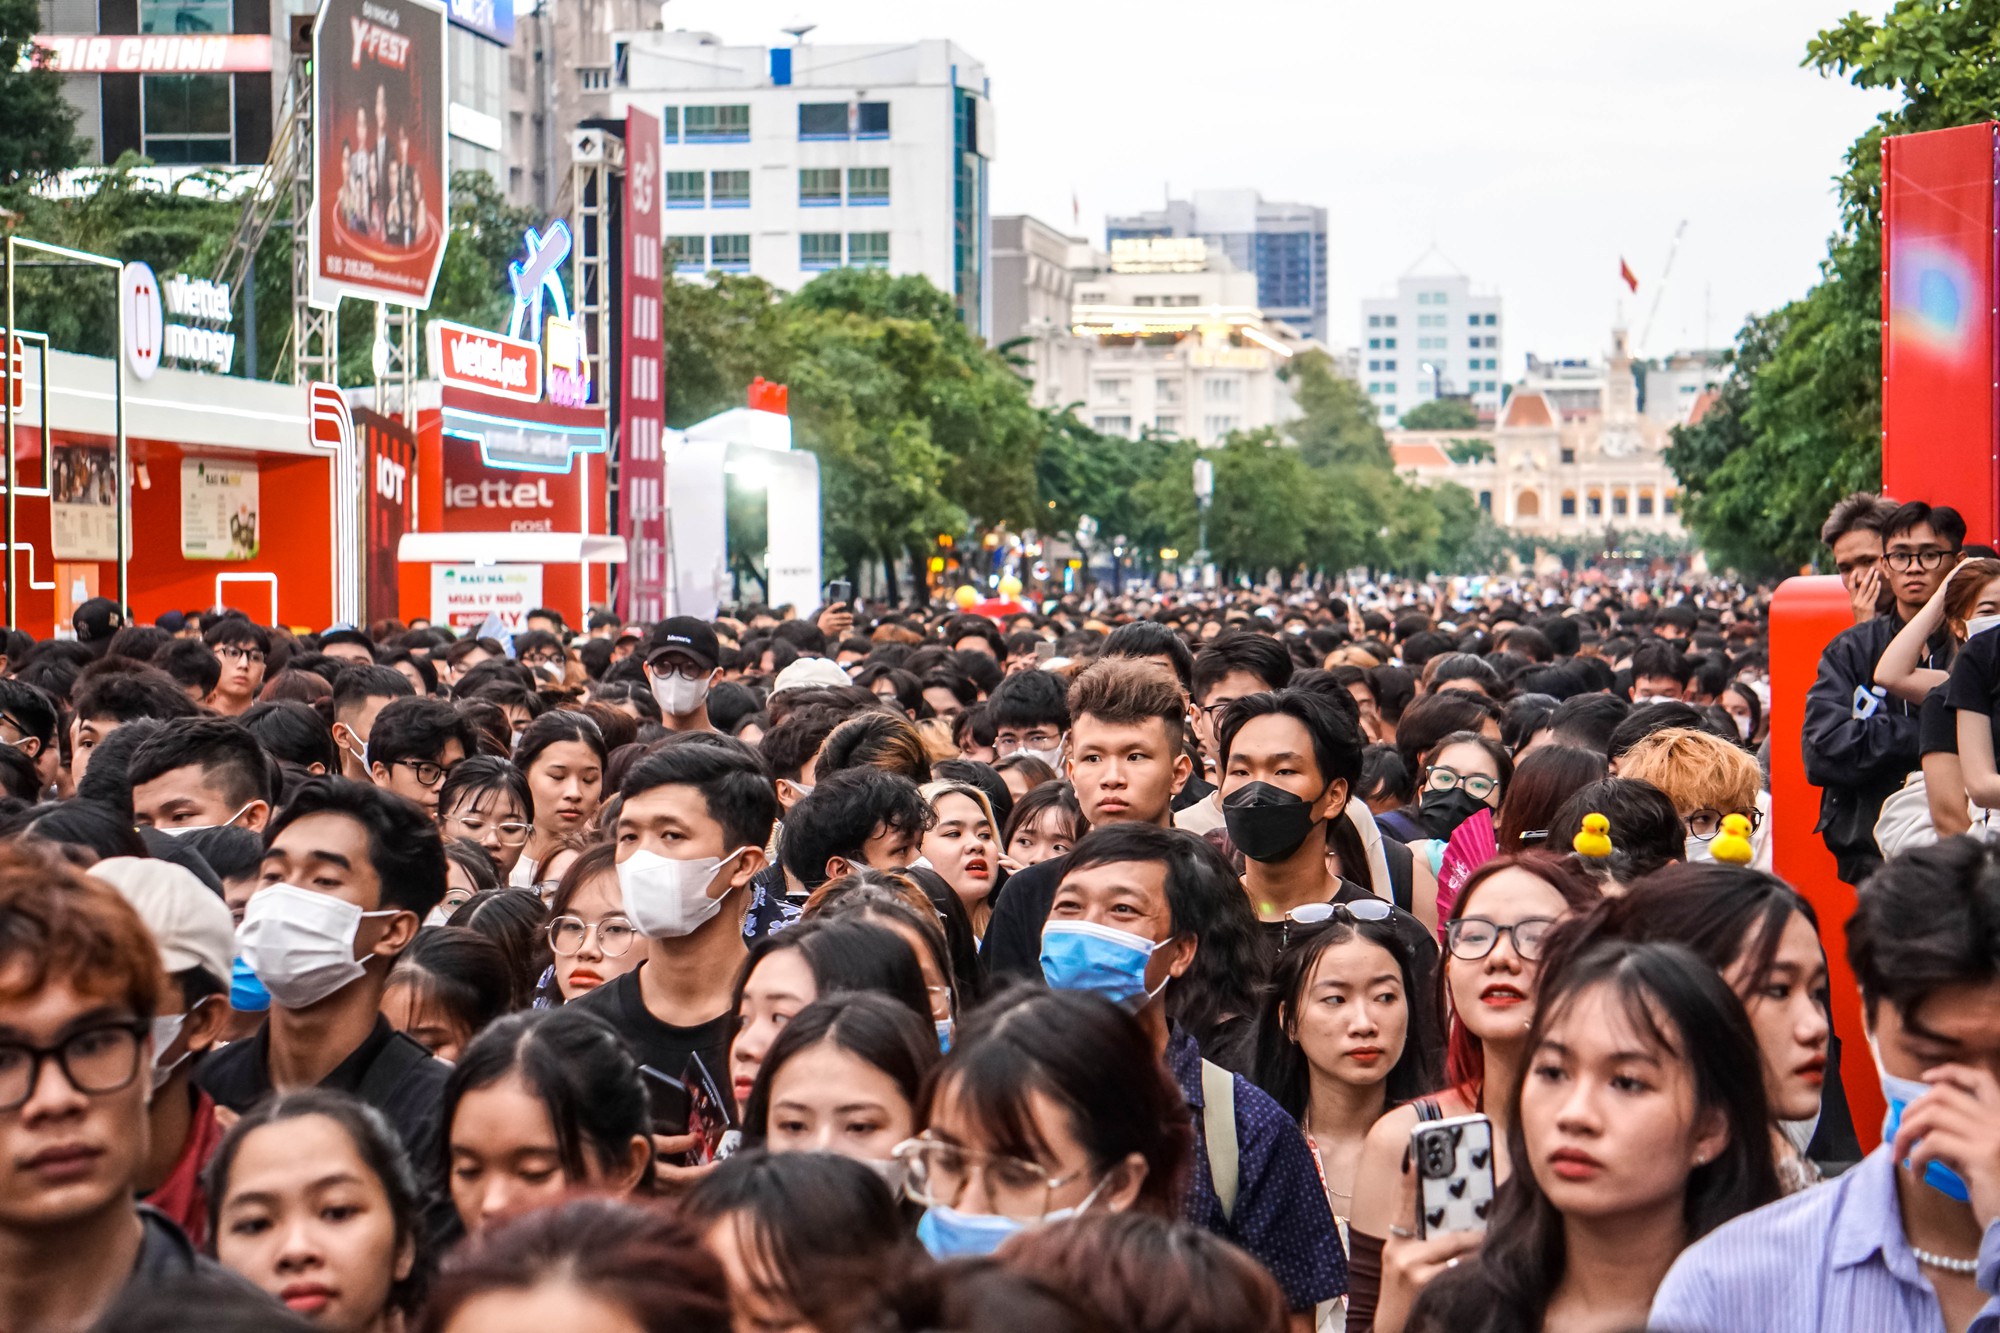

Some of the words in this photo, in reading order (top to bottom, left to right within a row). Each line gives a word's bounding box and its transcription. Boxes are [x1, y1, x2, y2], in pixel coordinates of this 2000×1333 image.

[53, 37, 111, 70] AIR
[116, 37, 228, 70] CHINA
[350, 16, 411, 67] Y-FEST
[168, 324, 236, 374] money
[376, 453, 406, 506] IOT
[444, 477, 554, 509] iettel
[511, 518, 553, 533] post
